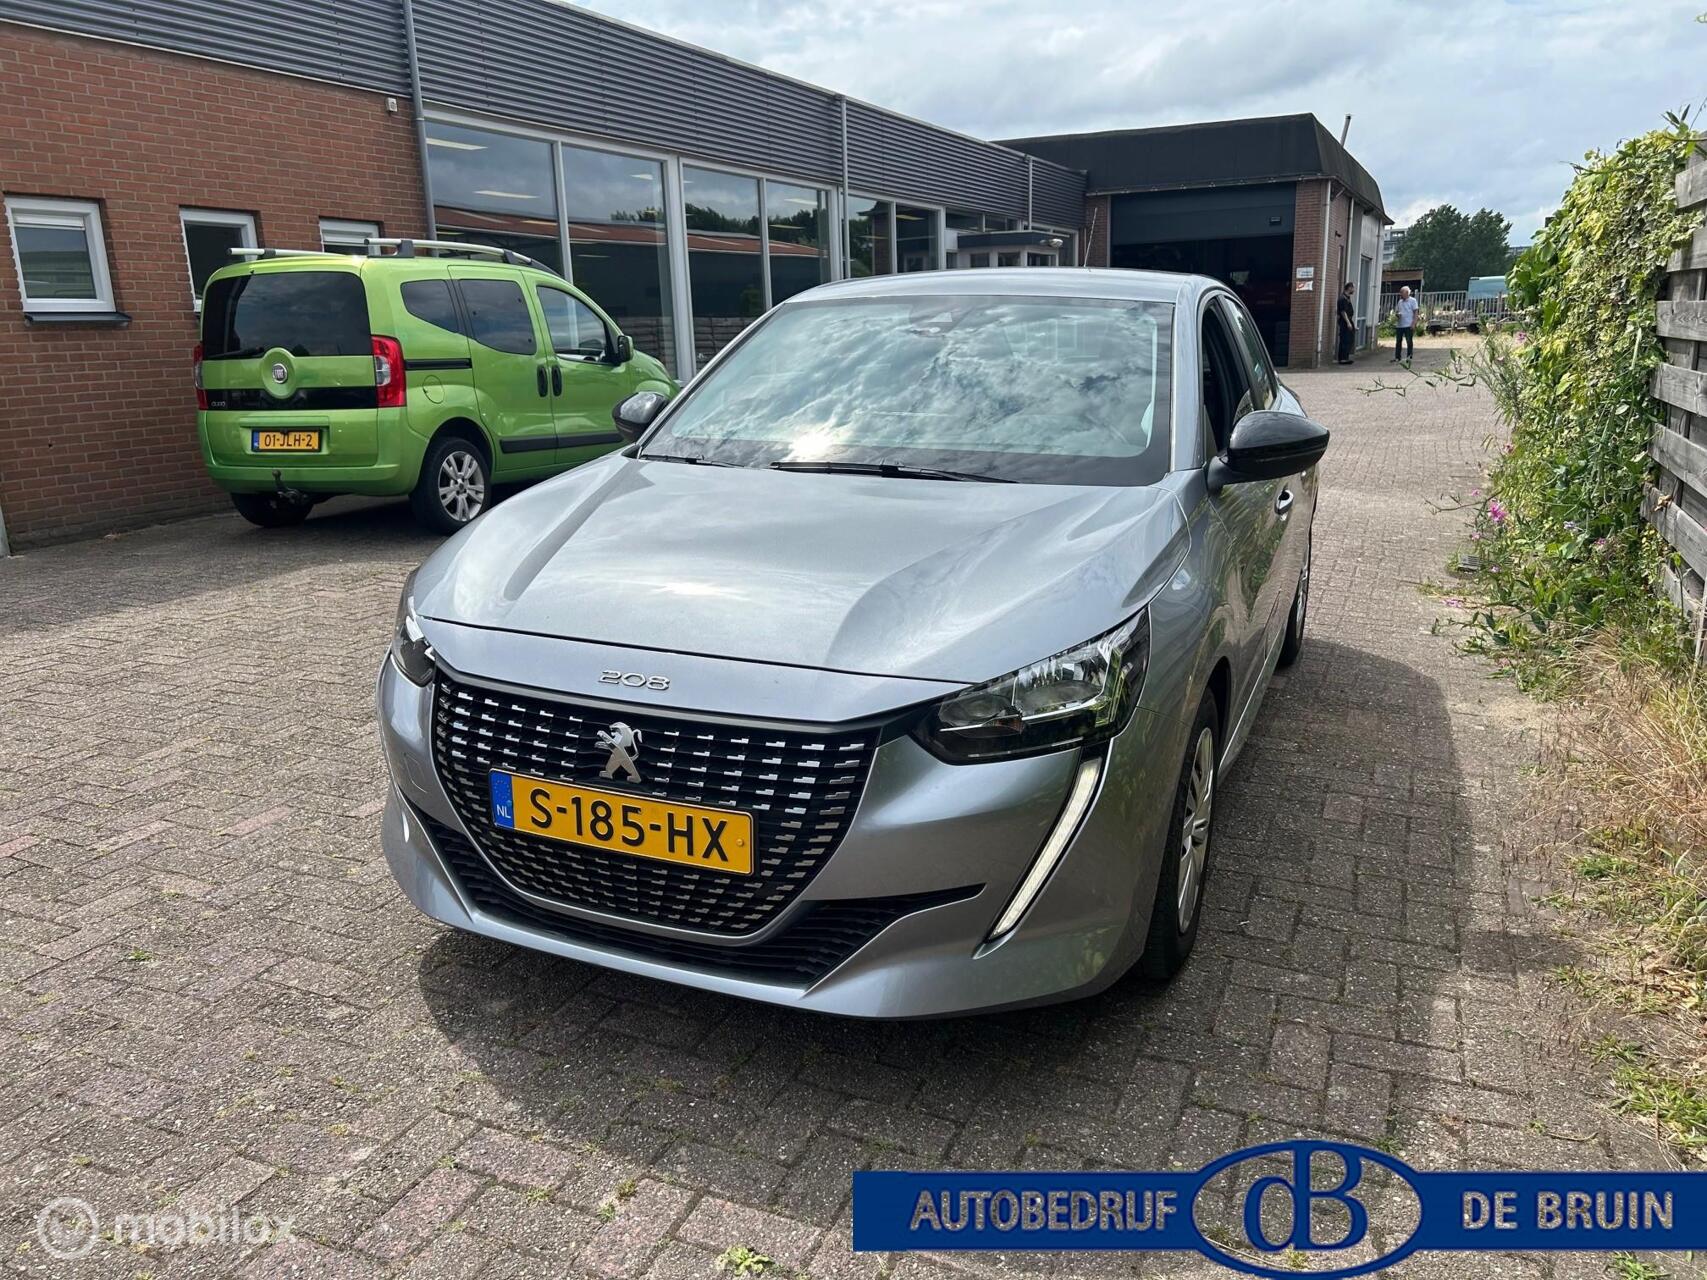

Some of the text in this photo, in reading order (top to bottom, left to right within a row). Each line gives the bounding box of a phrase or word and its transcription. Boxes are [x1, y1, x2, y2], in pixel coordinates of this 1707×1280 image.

[264, 434, 312, 447] 01-JLH-2
[598, 670, 670, 691] 208
[496, 804, 511, 819] NL
[529, 788, 729, 862] S-185-HX
